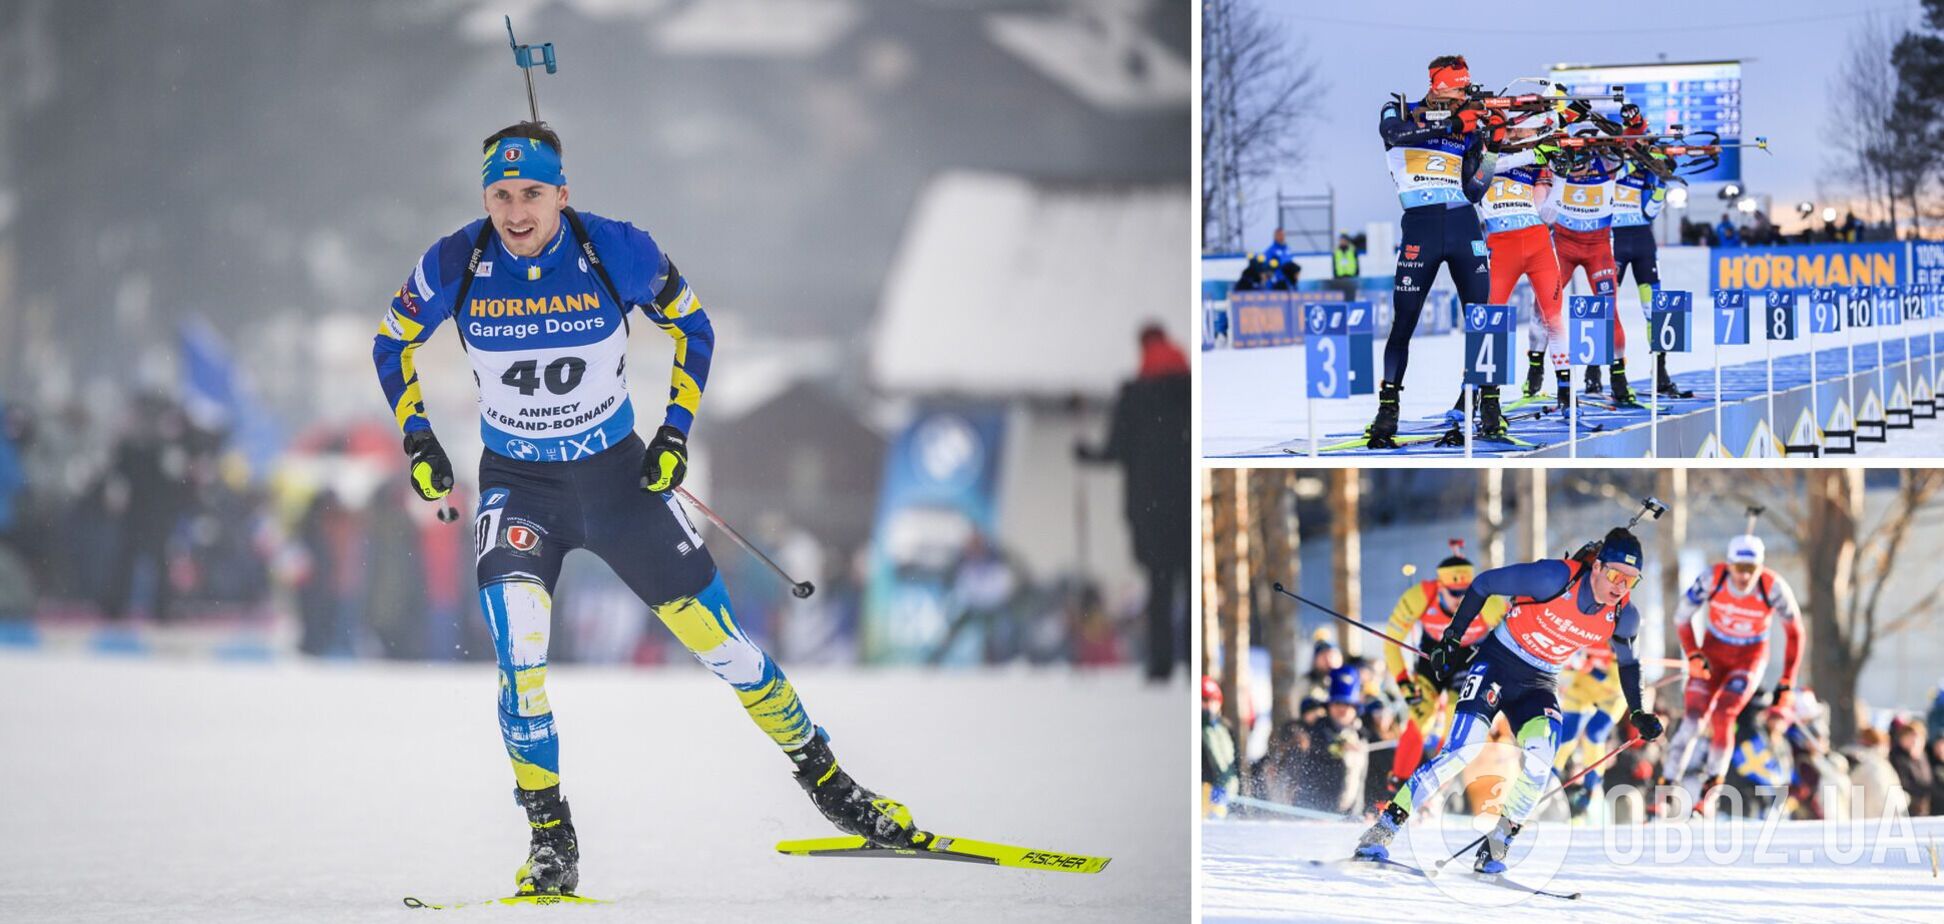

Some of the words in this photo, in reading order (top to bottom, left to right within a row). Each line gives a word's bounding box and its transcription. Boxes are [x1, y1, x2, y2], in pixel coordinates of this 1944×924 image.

[1426, 154, 1447, 172] 2
[1494, 180, 1524, 197] 14
[1572, 189, 1586, 203] 6
[1719, 253, 1896, 290] HÖRMANN
[469, 292, 600, 318] HÖRMANN
[1815, 303, 1828, 332] 9
[1849, 300, 1870, 327] 10
[1879, 300, 1896, 325] 11
[1904, 295, 1920, 319] 12
[469, 322, 539, 339] Garage
[546, 317, 605, 334] Doors
[1660, 312, 1676, 351] 6
[1722, 309, 1736, 343] 7
[1773, 307, 1787, 340] 8
[1579, 320, 1595, 364] 5
[1316, 337, 1337, 397] 3
[1475, 333, 1496, 383] 4
[500, 356, 587, 396] 40
[487, 407, 497, 420] LE
[499, 395, 615, 431] GRAND-BORNAND
[519, 402, 581, 418] ANNECY
[559, 427, 609, 461] iX1
[1544, 608, 1602, 641] VIESSMANN
[1020, 852, 1087, 869] FISCHER
